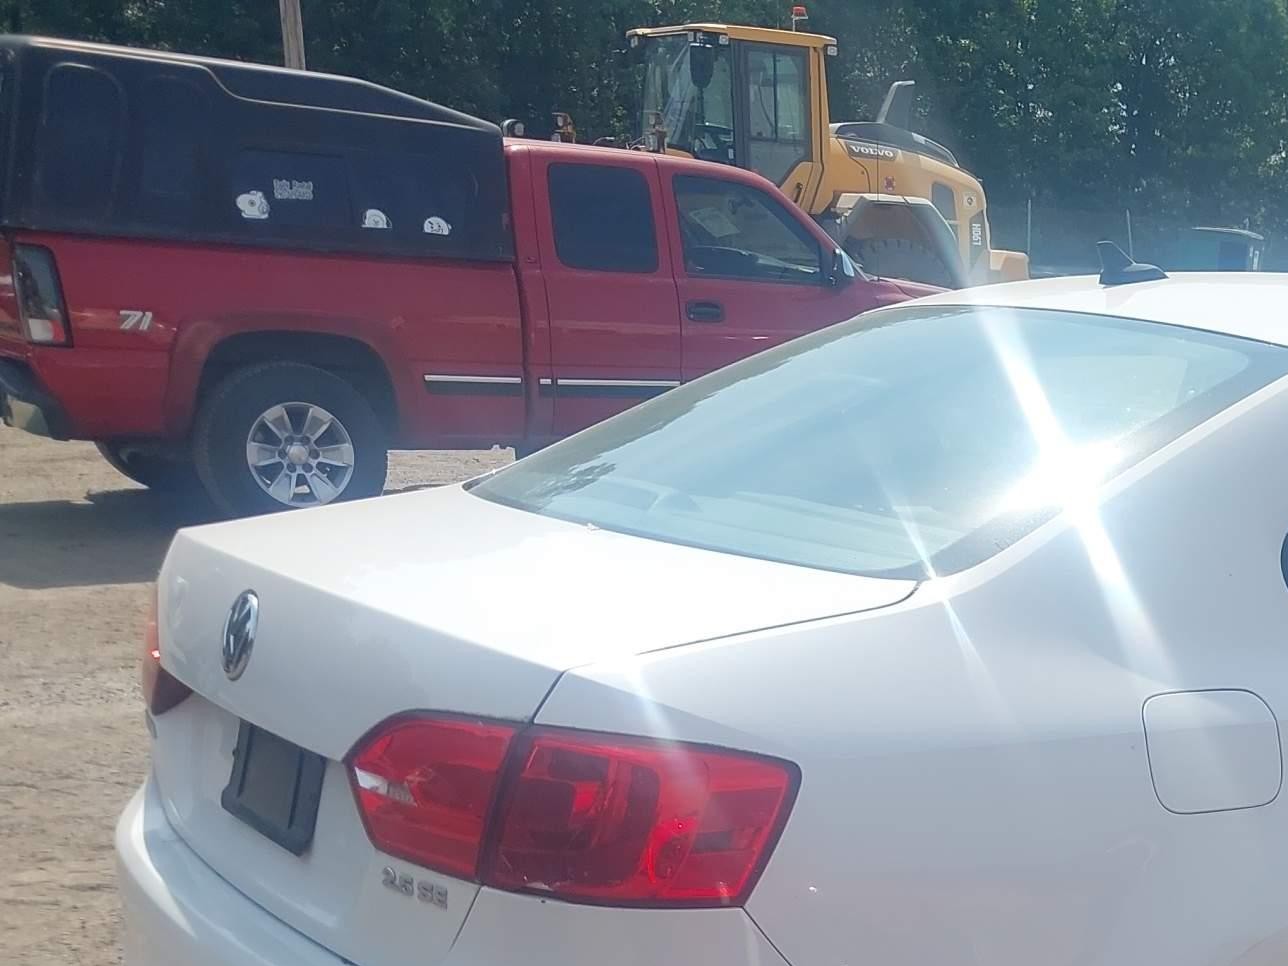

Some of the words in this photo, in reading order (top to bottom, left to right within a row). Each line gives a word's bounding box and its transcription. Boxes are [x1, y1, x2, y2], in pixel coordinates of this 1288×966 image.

[849, 144, 894, 158] VOLVO
[972, 223, 982, 246] L90H
[119, 309, 153, 331] 71
[417, 879, 448, 912] SE
